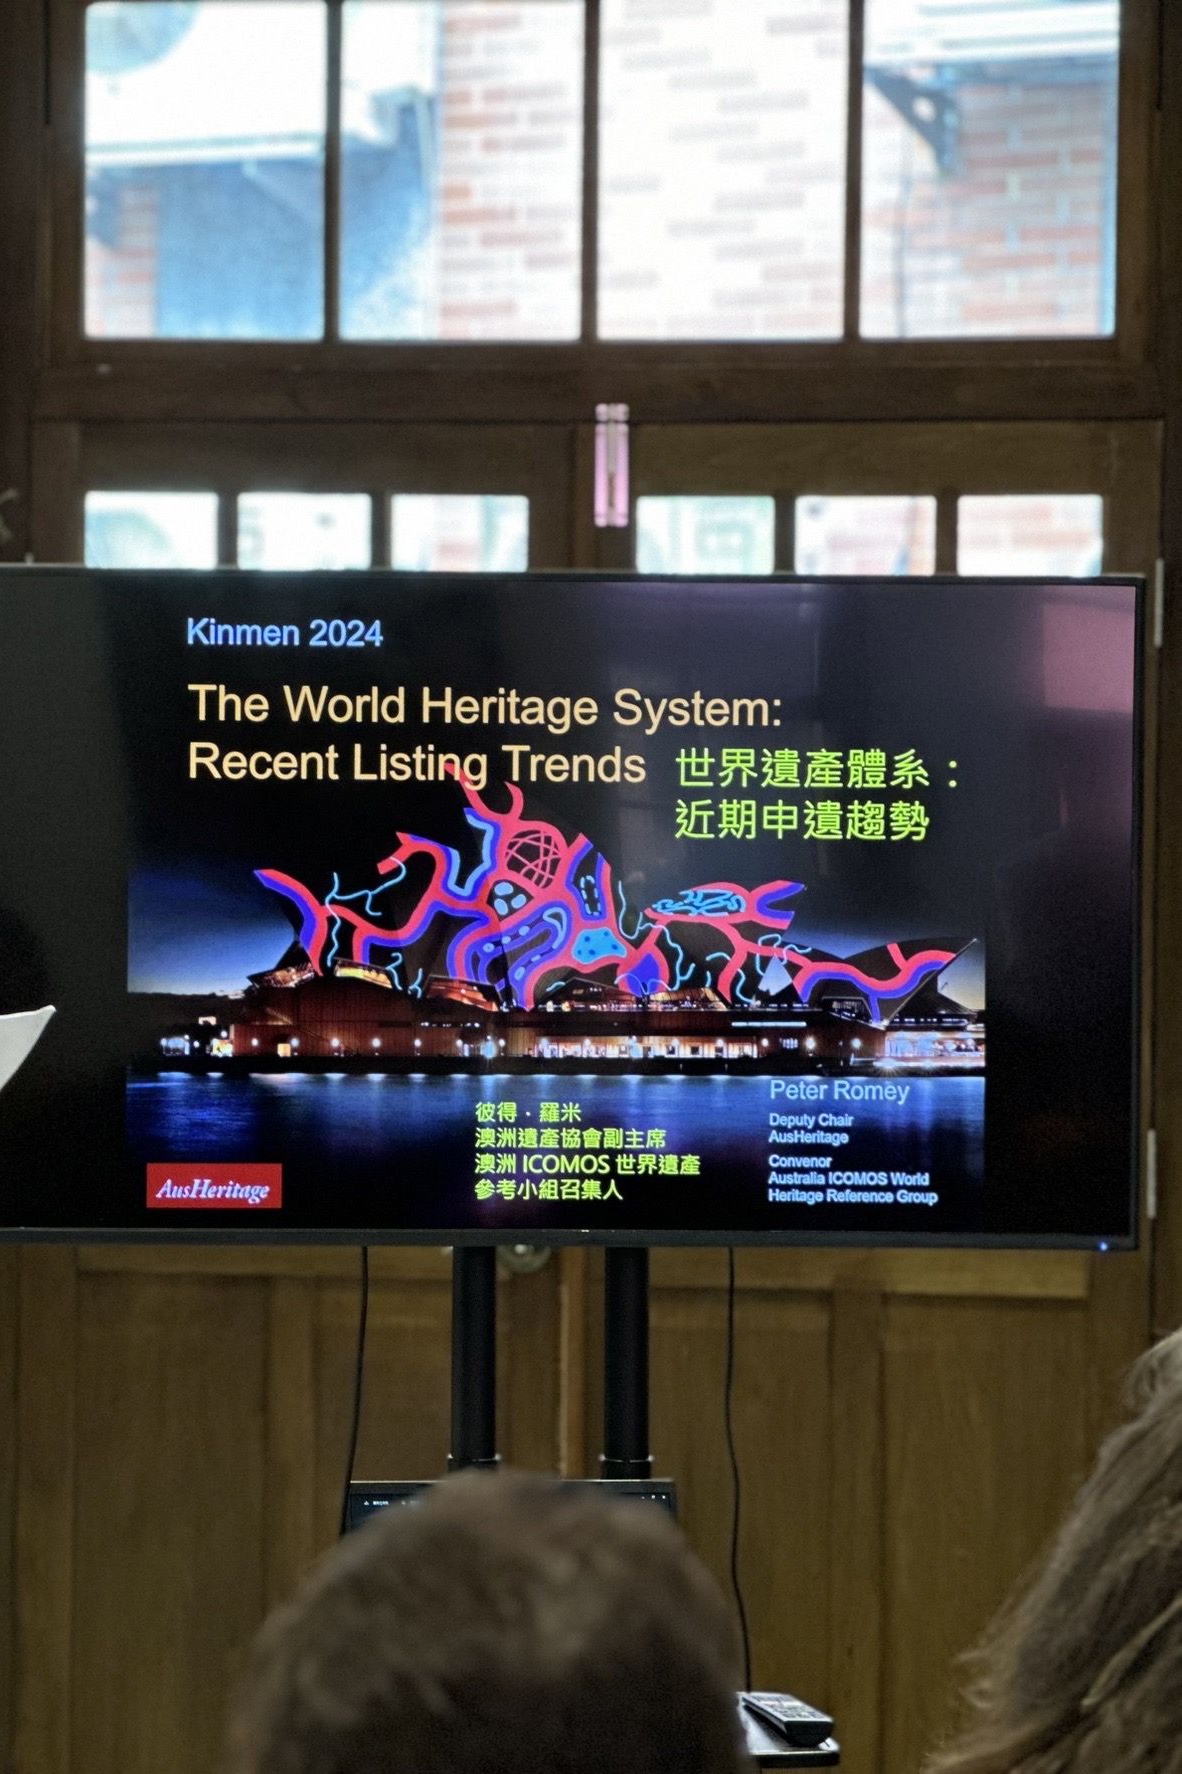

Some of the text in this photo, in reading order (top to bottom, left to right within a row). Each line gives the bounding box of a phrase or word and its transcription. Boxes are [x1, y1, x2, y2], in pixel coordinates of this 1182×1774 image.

[187, 618, 384, 647] Kinmen 2024
[187, 684, 782, 735] The World Heritage System:
[189, 742, 646, 790] Recent Listing Trends
[675, 799, 930, 841] 近期申遺趨勢
[770, 1080, 910, 1105] Peter Romey
[769, 1113, 854, 1129] Deputy Chair
[475, 1127, 666, 1149] 澳洲遺產協會副主席
[768, 1130, 849, 1146] AusHeritage
[475, 1153, 701, 1175] 澳洲 ICOMOS 世界遺產
[768, 1155, 832, 1168] Convenor
[475, 1178, 623, 1200] 參考小組召集人
[768, 1171, 930, 1186] Australia ICOMOS World
[155, 1178, 270, 1204] AusHeritage
[768, 1189, 938, 1206] Heritage Reference Group
